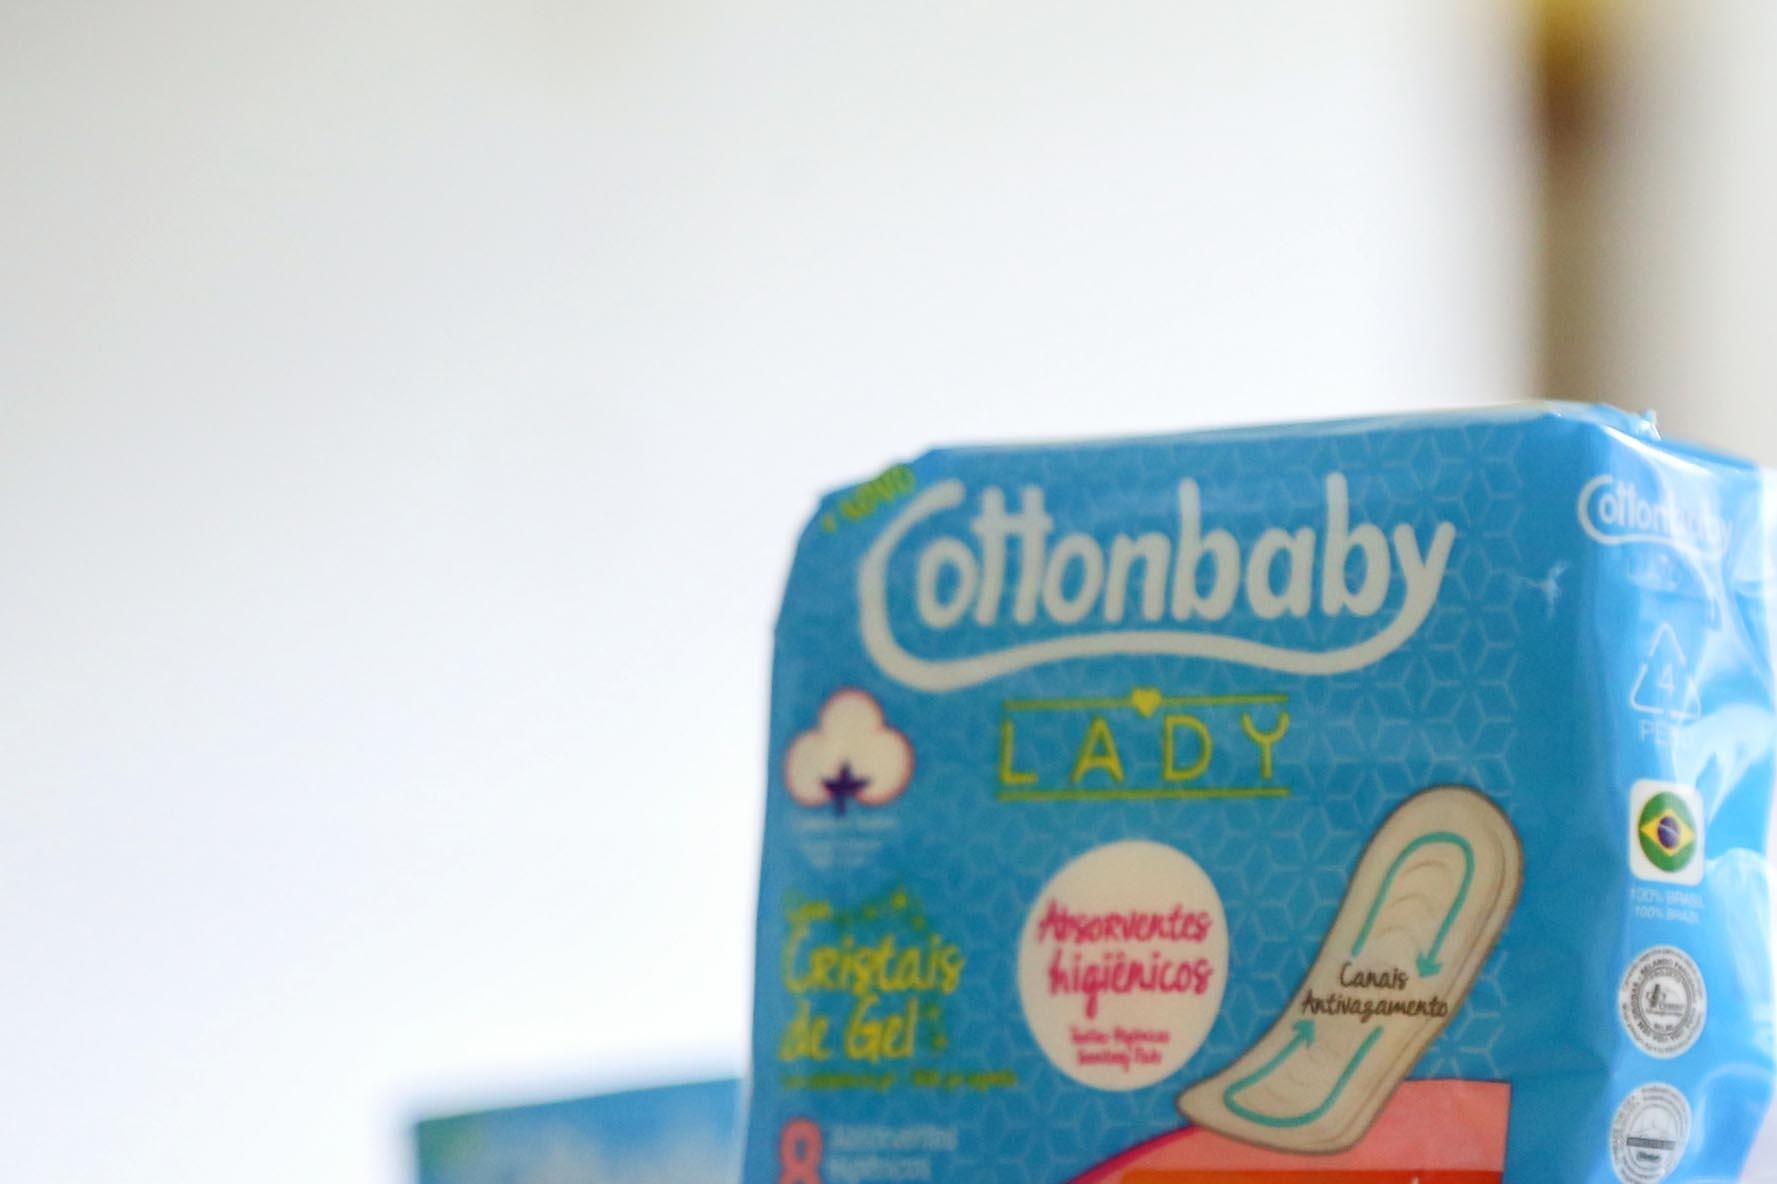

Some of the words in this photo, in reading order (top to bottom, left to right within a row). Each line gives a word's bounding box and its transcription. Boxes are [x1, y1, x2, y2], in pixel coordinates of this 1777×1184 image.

[857, 472, 1457, 692] Cottonbaby
[1001, 711, 1290, 785] LADY
[1037, 901, 1214, 943] Absorventes
[1339, 962, 1409, 991] Canais
[845, 994, 919, 1061] Gel
[1301, 994, 1450, 1022] Antivazamento
